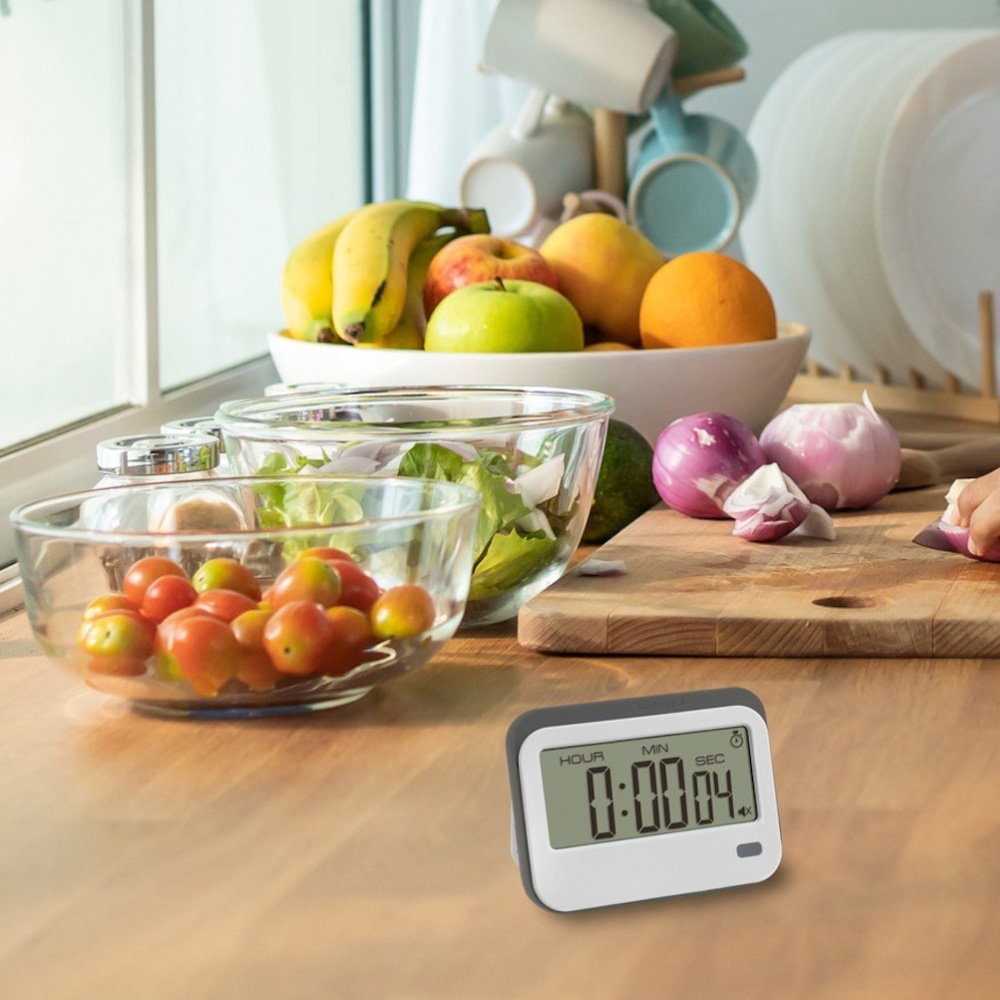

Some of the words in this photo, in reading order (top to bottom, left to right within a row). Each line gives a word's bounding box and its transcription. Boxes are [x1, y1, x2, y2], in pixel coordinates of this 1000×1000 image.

[559, 751, 605, 766] HOUR
[641, 743, 669, 756] MIN
[695, 753, 726, 767] SEC
